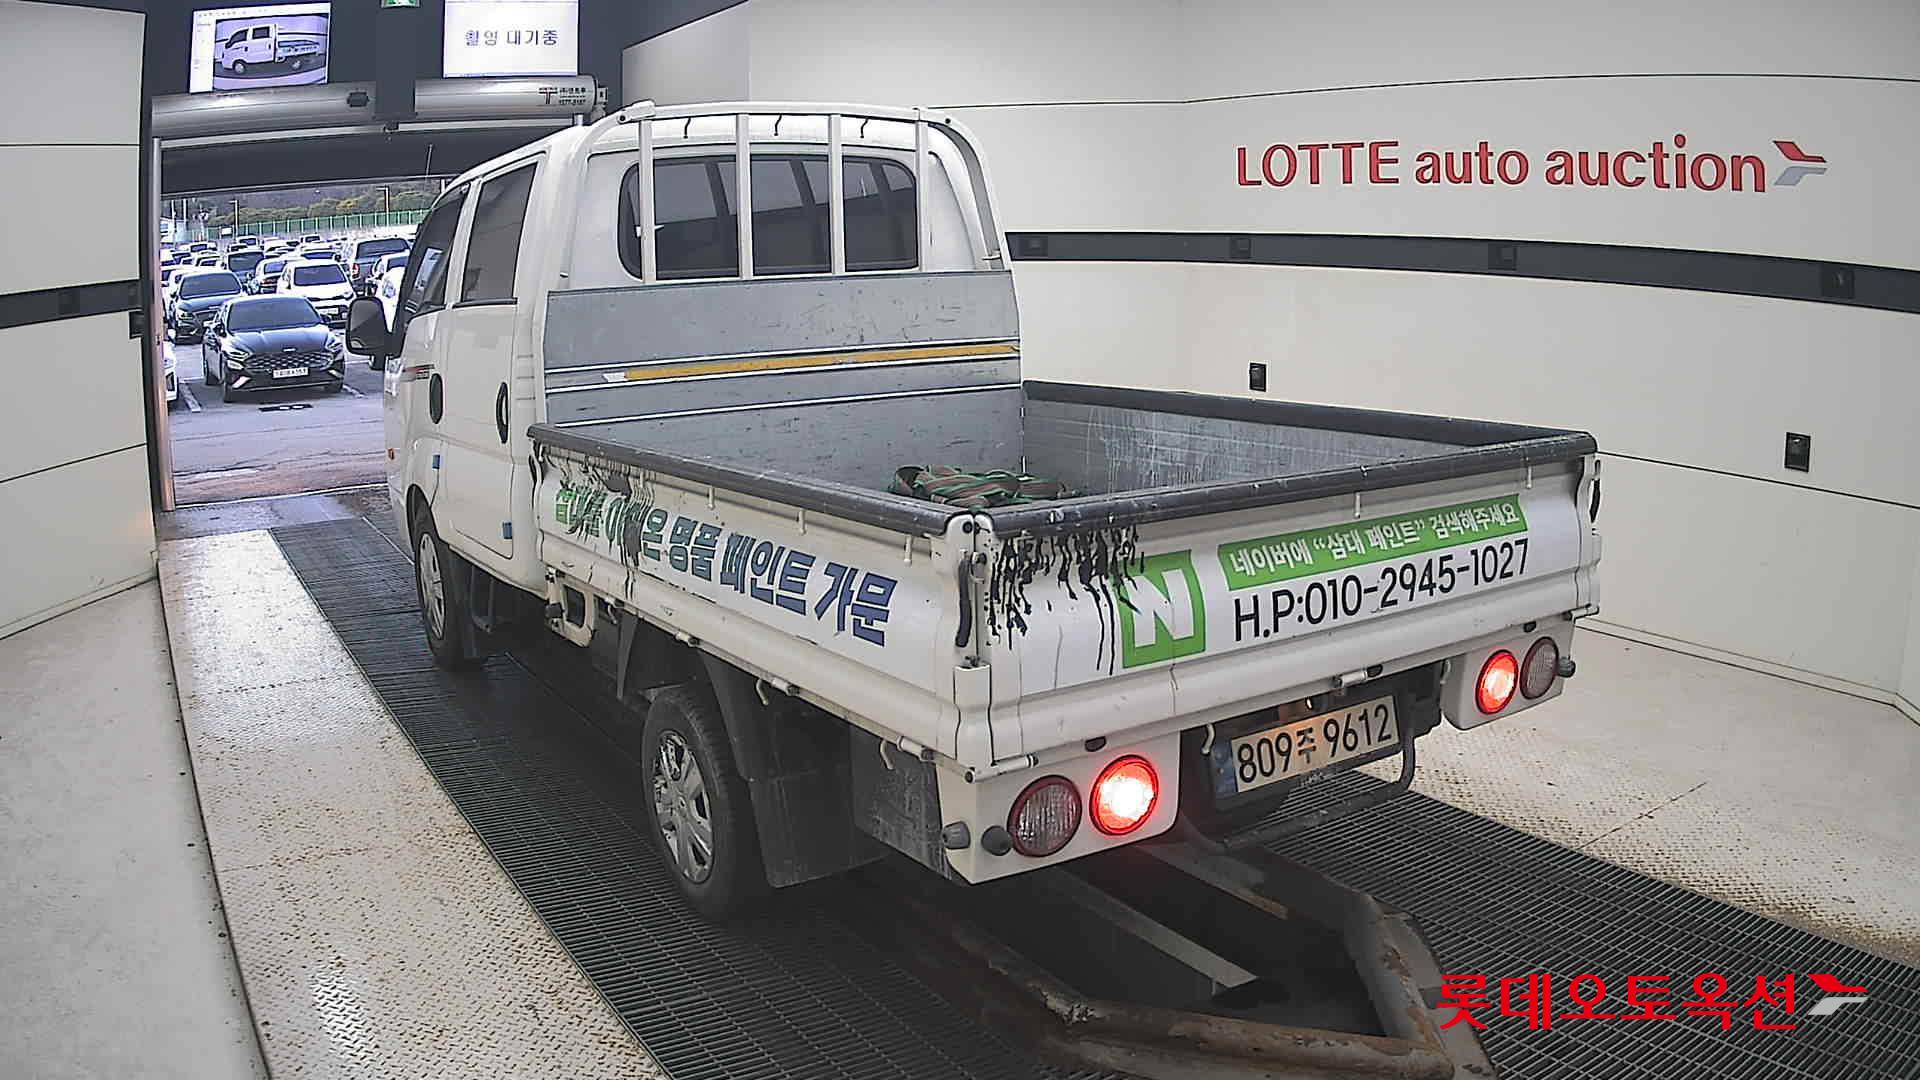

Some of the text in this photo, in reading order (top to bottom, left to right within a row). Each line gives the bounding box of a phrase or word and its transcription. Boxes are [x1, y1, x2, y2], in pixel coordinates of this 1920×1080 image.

[506, 29, 558, 46] 대기중
[1236, 134, 1766, 193] LOTTE auto auction
[1229, 538, 1314, 576] 네이버에
[1428, 502, 1520, 540] 검색해주세요
[668, 515, 723, 582] 명품
[720, 532, 817, 616] 페인트
[814, 561, 899, 648] 가문
[1233, 538, 1529, 642] H.P:010-2945-1027
